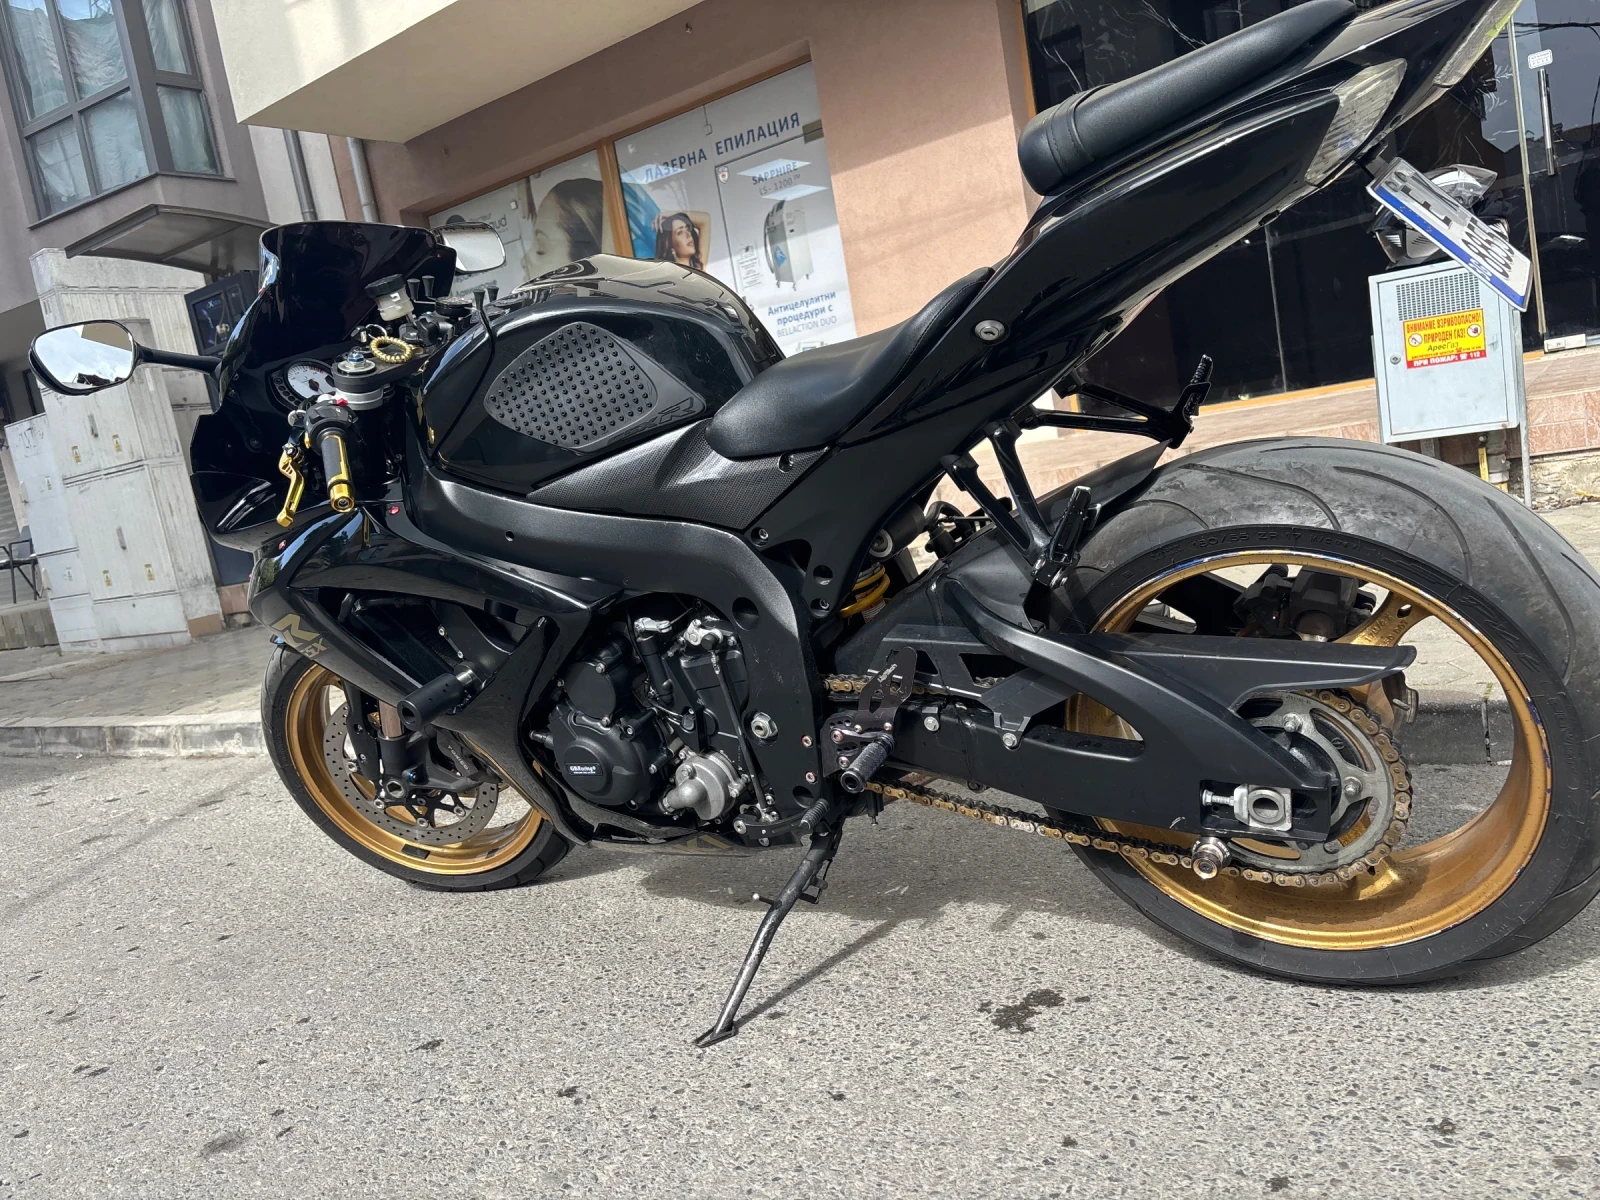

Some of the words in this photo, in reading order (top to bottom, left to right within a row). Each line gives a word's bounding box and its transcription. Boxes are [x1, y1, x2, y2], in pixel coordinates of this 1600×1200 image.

[644, 148, 708, 183] ЛАЗЕРНА
[715, 112, 800, 156] ЕПИЛАЦИЯ
[751, 161, 798, 186] SAPPHIRE
[1460, 216, 1515, 279] 8855
[767, 291, 837, 316] Антицелулитни
[777, 307, 826, 327] процедури
[827, 304, 833, 312] с
[777, 319, 819, 338] BELLACTION
[820, 315, 837, 327] DUO
[1406, 319, 1436, 334] ВНИМАНИЕ
[1436, 311, 1482, 329] ВЗРИВООПАСНО!
[1423, 330, 1453, 344] ПРИРОДЕН
[1453, 327, 1466, 340] ГАЗ!
[1413, 359, 1429, 367] ПРИ
[1430, 354, 1459, 364] ПОЖАР:
